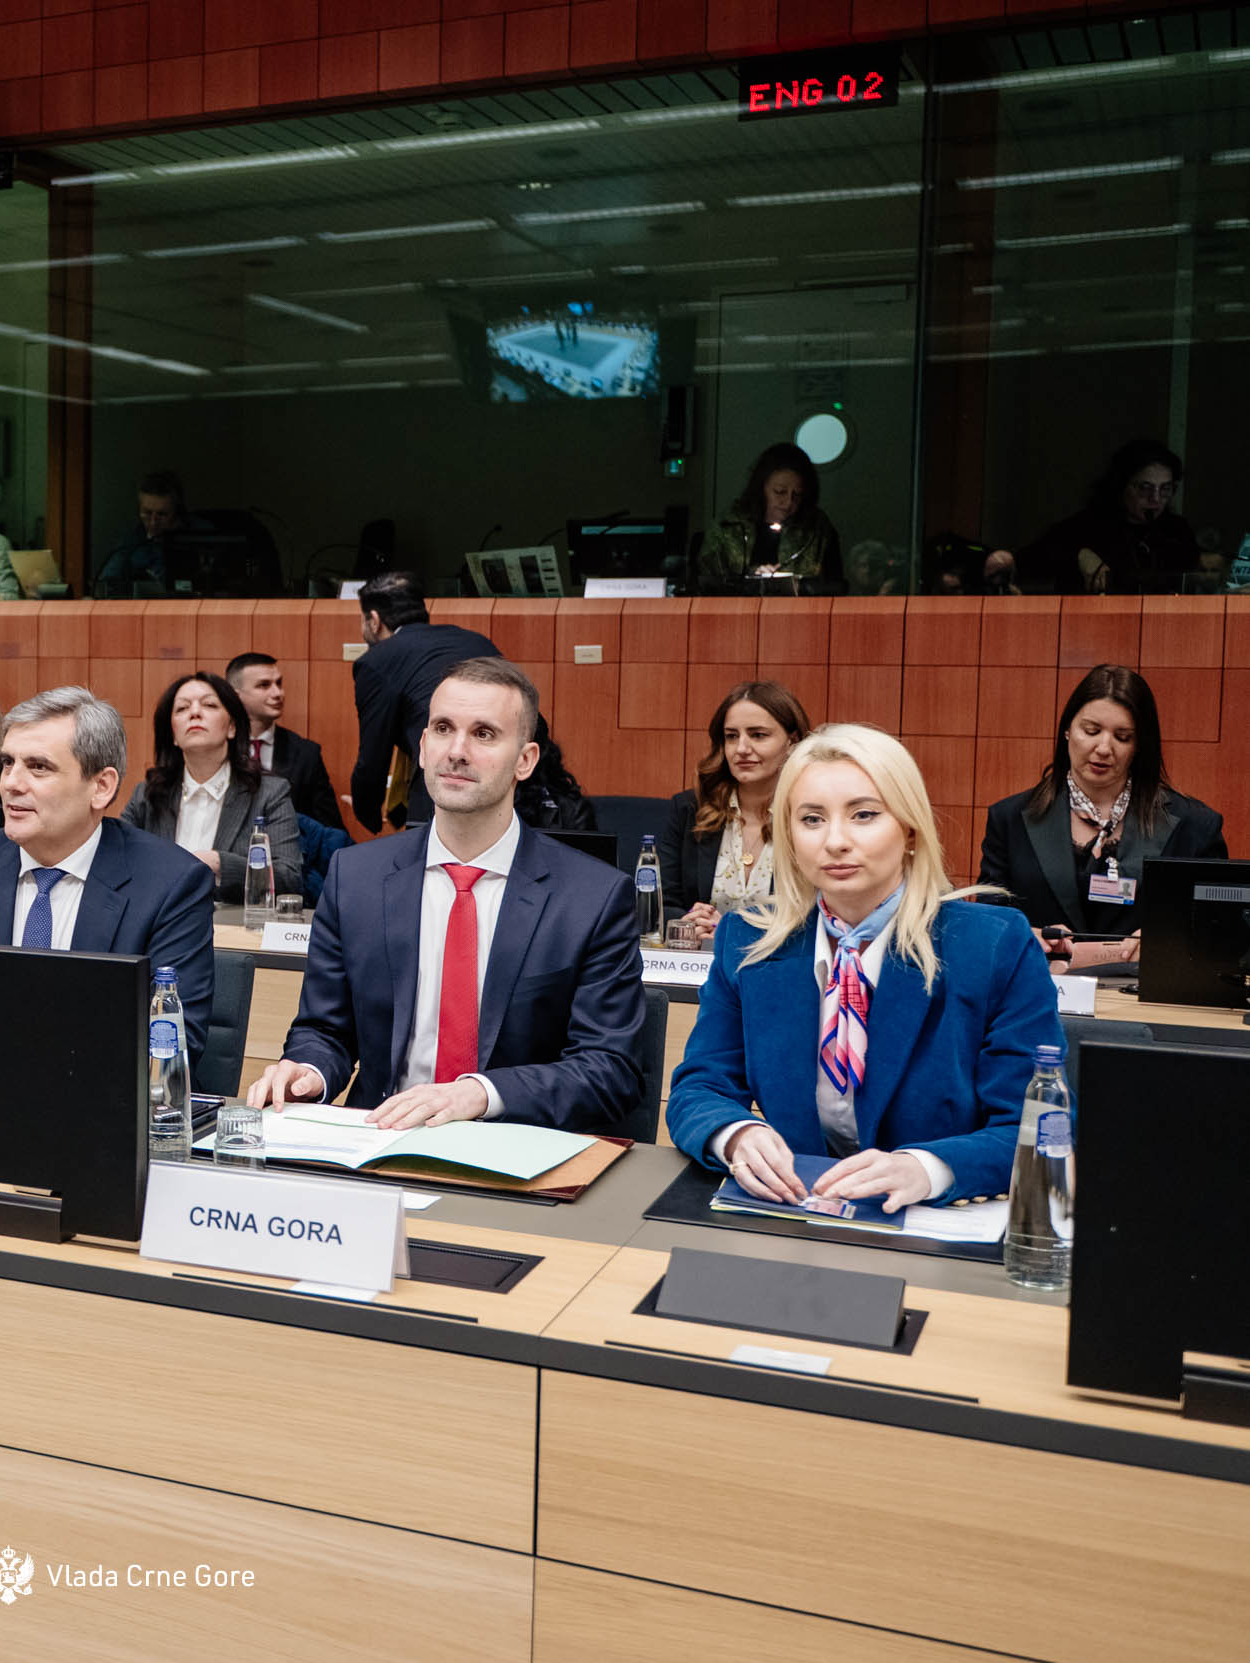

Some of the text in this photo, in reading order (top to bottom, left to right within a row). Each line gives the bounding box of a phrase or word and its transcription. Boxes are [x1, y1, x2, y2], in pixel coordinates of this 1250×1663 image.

[748, 71, 884, 113] ENG 02
[284, 932, 311, 942] CRN
[680, 961, 709, 973] GOR
[189, 1206, 343, 1245] CRNA GORA
